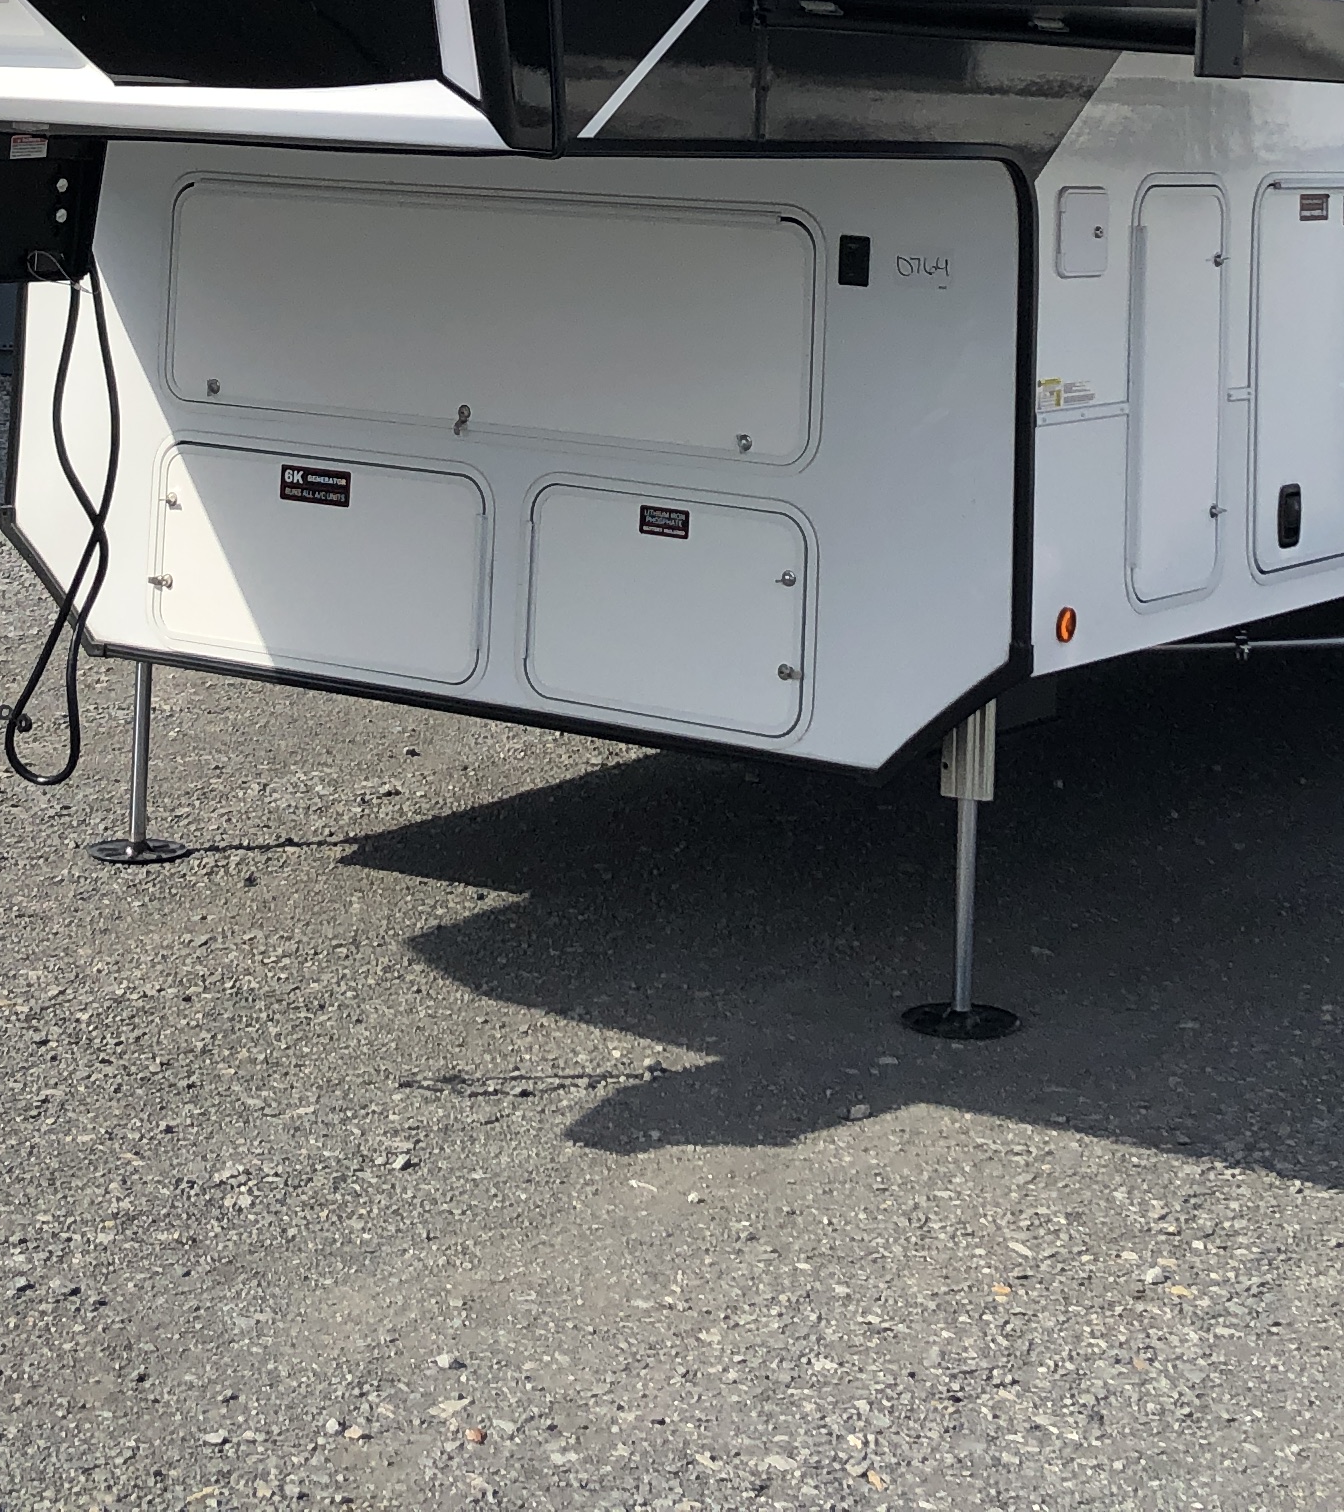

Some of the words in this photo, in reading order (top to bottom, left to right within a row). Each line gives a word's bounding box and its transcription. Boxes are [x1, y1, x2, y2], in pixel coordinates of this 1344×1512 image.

[284, 469, 304, 484] 6K
[307, 474, 347, 485] GENERATOR
[284, 487, 302, 496] RUNS
[303, 489, 314, 498] ALL
[314, 491, 326, 500] A/C
[326, 492, 346, 502] UNITS
